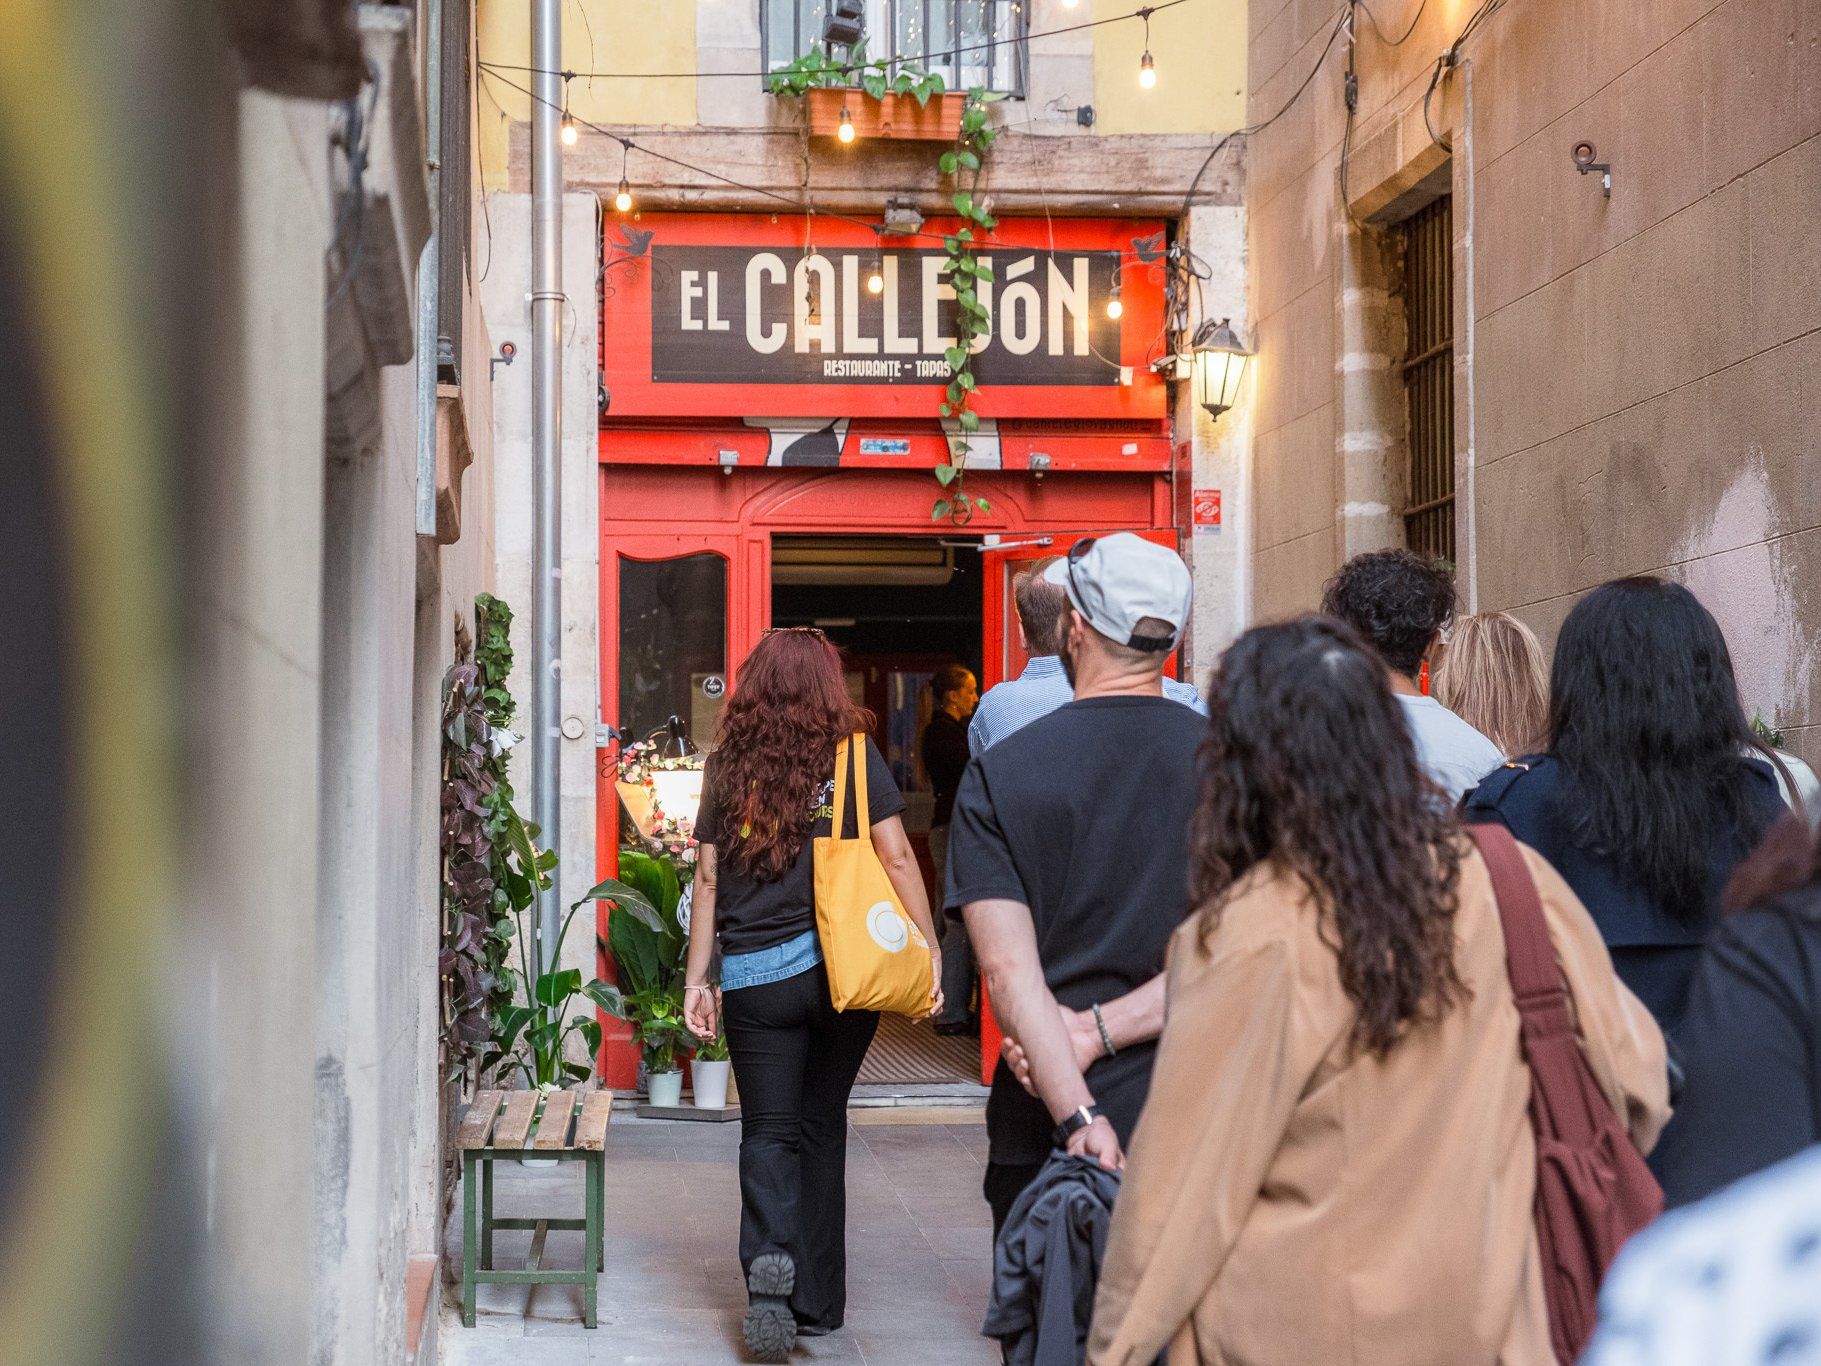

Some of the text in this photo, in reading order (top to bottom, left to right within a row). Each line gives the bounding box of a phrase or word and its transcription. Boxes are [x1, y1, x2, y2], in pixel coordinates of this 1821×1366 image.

[681, 270, 730, 329] EL
[824, 360, 901, 377] RESTAURANTE
[915, 360, 952, 377] TAPAS
